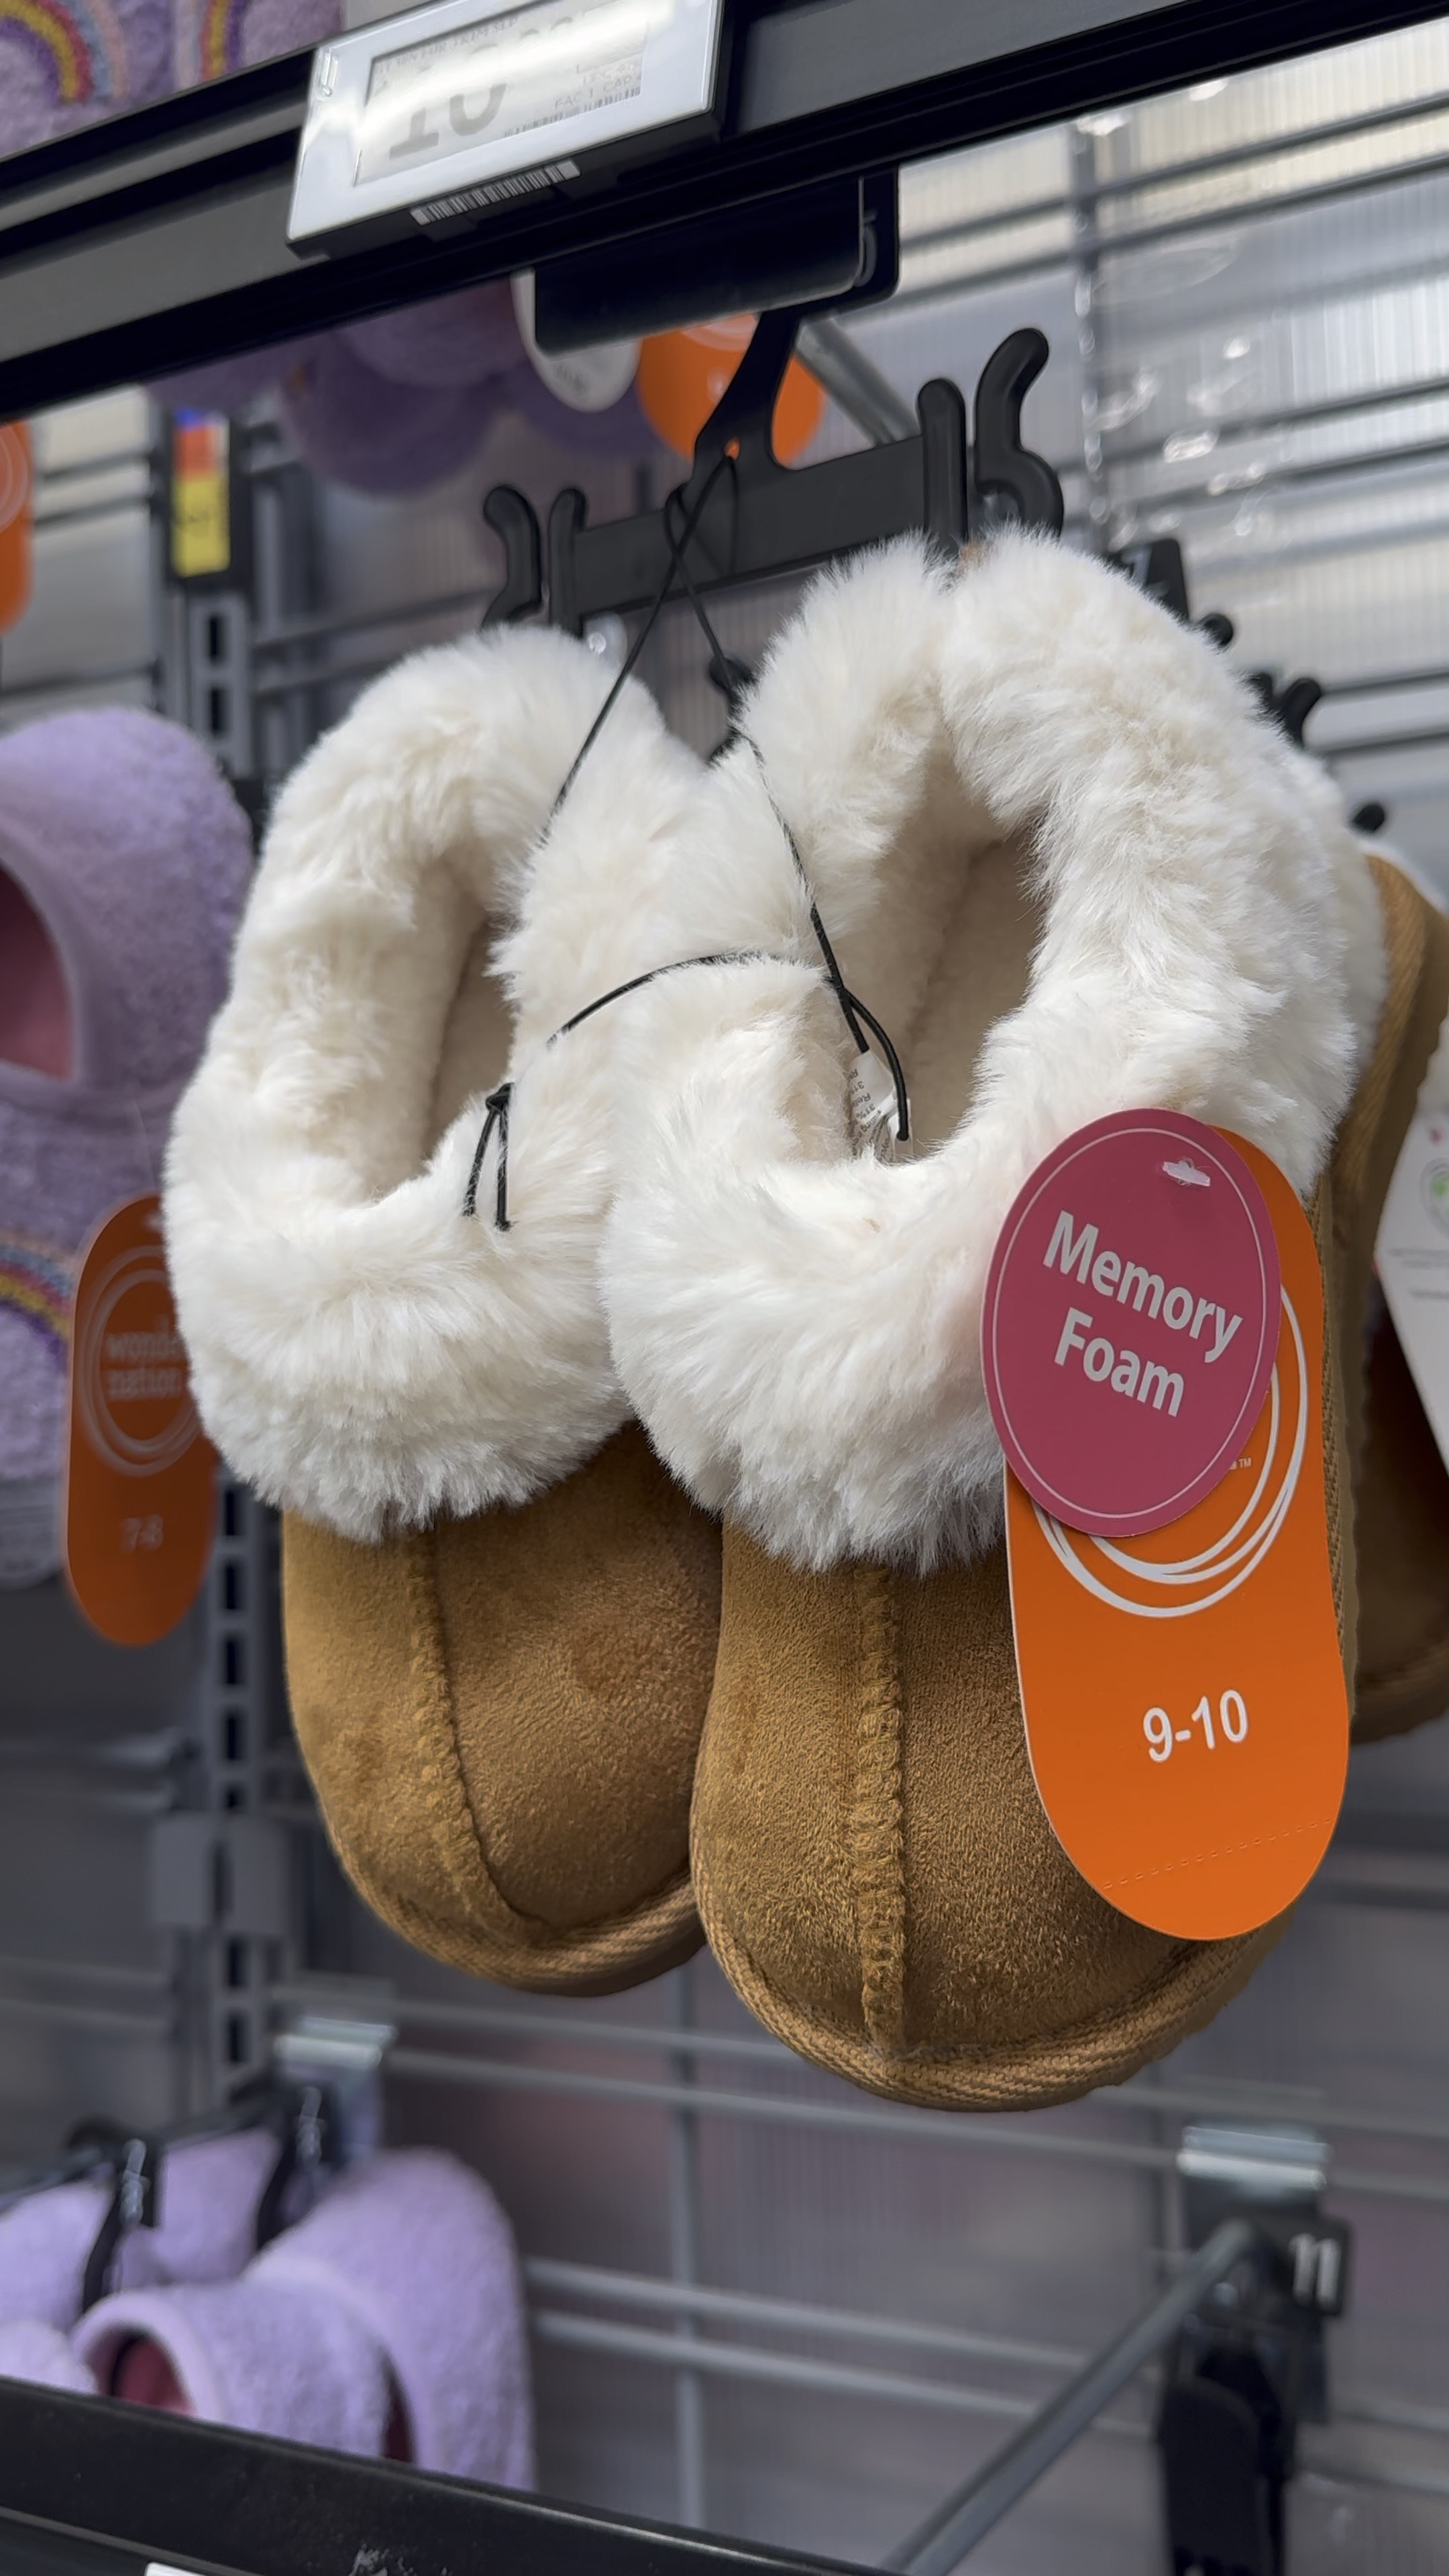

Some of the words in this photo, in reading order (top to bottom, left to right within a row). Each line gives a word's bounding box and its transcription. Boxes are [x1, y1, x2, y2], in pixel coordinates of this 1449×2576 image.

[1043, 1210, 1242, 1363] Memory
[1054, 1307, 1185, 1418] Foam
[1143, 1689, 1248, 1762] 9-10
